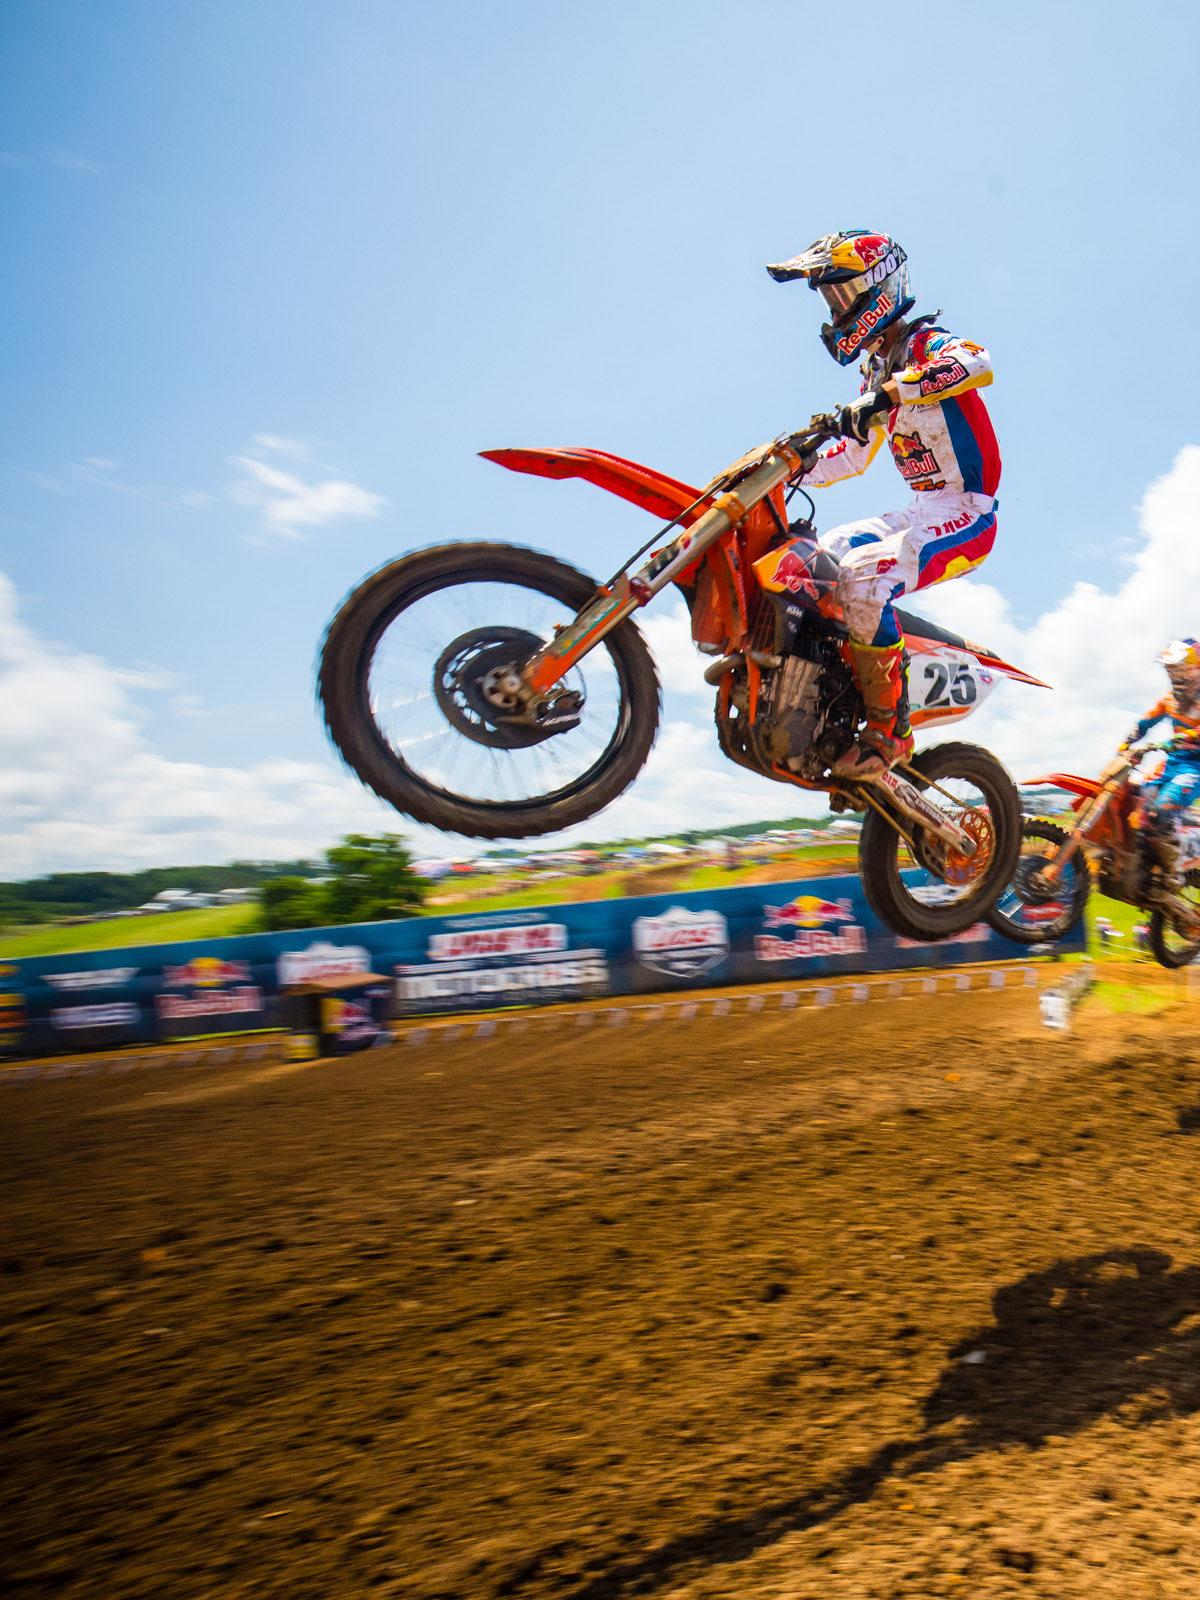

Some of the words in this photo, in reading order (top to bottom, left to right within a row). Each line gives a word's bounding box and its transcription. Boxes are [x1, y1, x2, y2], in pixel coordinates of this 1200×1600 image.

[837, 319, 871, 355] Red
[861, 293, 892, 328] Bull
[921, 374, 945, 395] Red
[942, 363, 965, 384] Bull
[908, 452, 937, 476] Bull
[924, 662, 976, 705] 25
